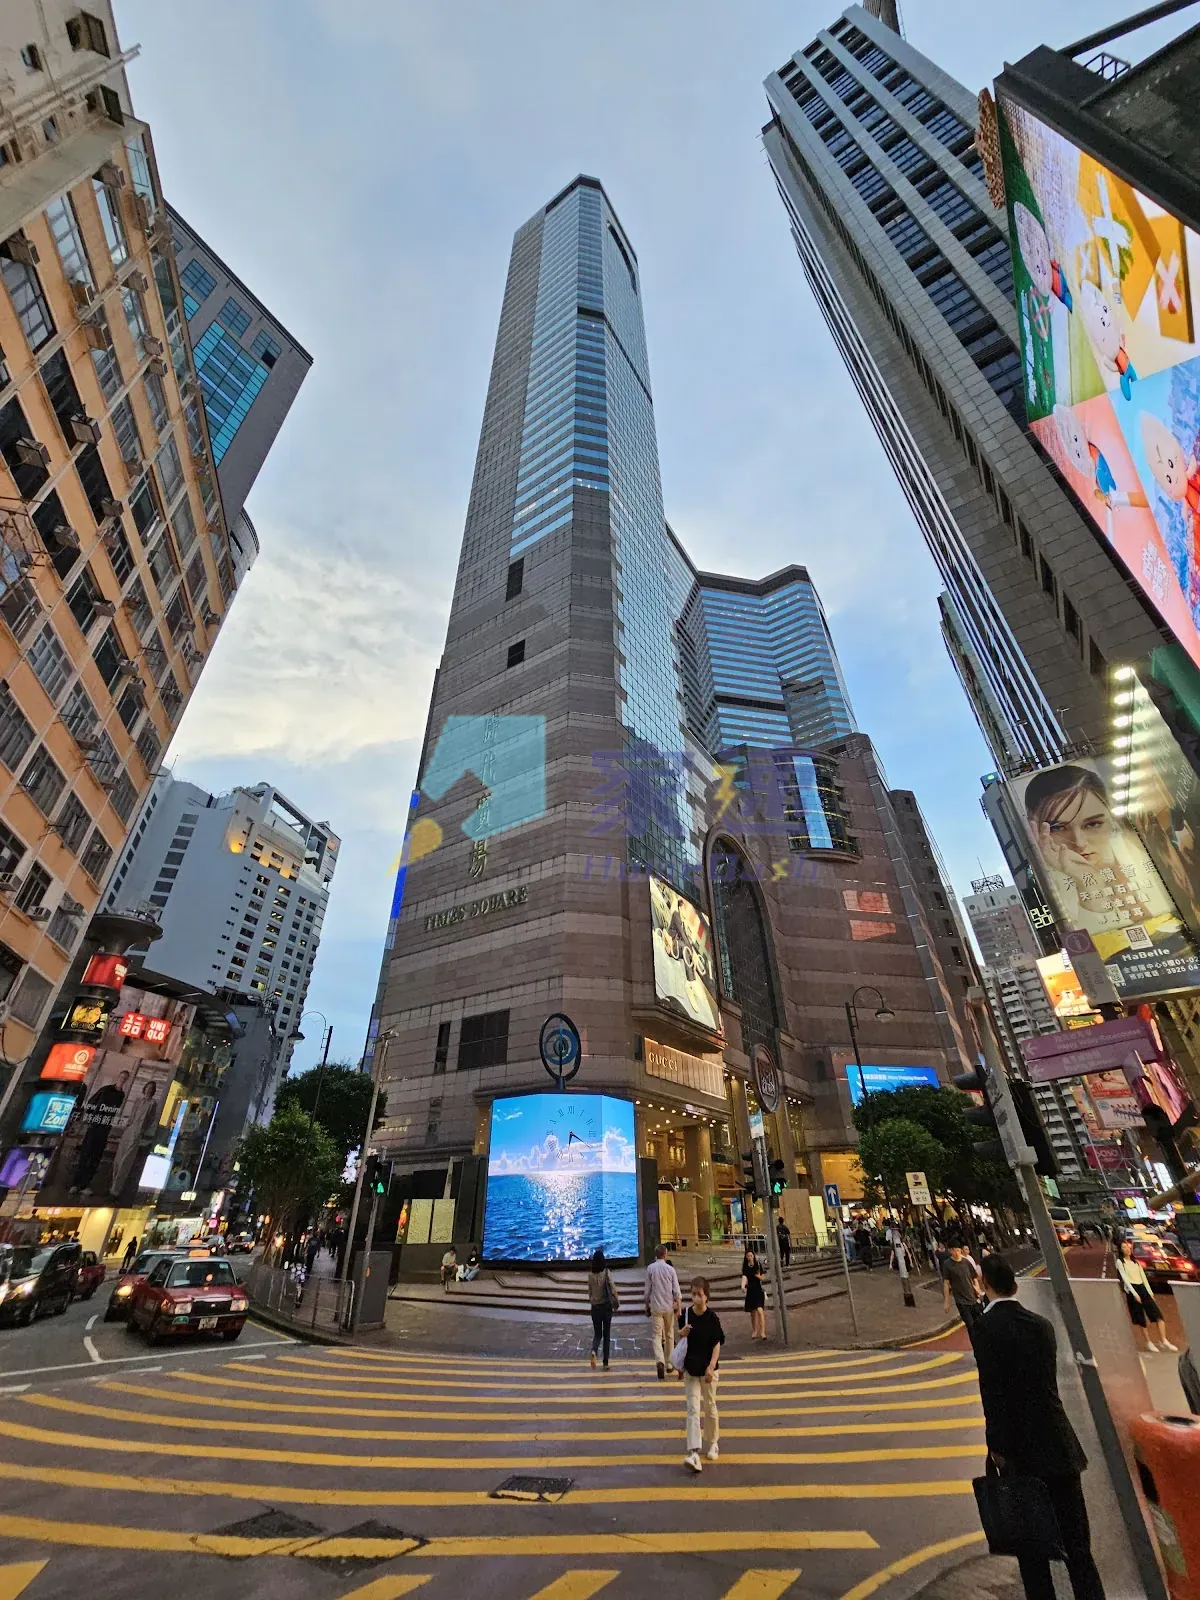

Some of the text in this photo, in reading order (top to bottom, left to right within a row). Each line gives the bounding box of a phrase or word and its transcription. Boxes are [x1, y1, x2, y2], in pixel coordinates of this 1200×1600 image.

[425, 885, 529, 931] TIMES SQUARE
[1122, 948, 1170, 962] MaBelle
[648, 1051, 678, 1072] GUCCI
[81, 1101, 121, 1114] New Denim
